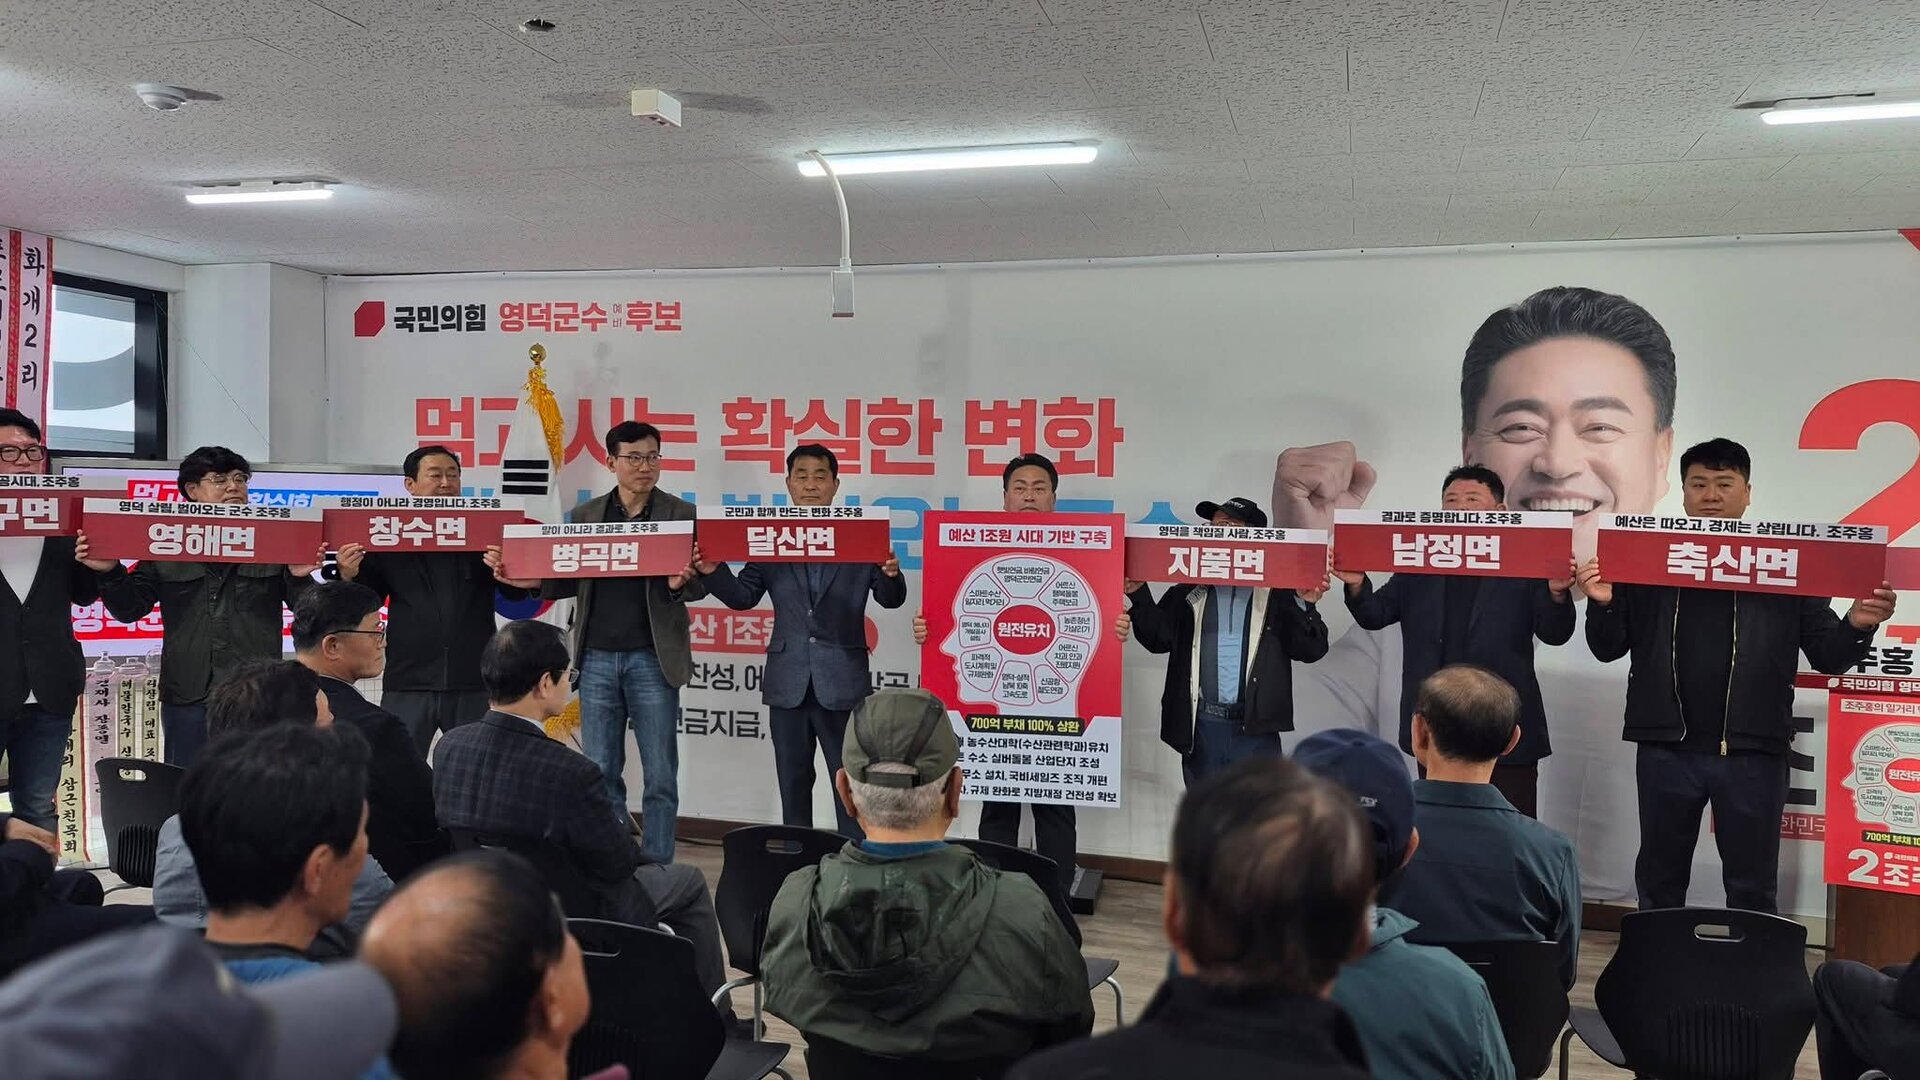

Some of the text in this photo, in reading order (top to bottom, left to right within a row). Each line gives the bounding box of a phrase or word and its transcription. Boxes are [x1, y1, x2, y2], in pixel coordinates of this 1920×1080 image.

[21, 247, 45, 391] 화개2리
[394, 304, 486, 332] 국민의힘
[499, 302, 607, 332] 영덕군수
[626, 301, 682, 331] 후보
[721, 397, 943, 475] 확실한
[965, 398, 1124, 477] 변화
[42, 477, 80, 487] 조주홍
[119, 501, 291, 518] 영덕 살림, 벌어오는 군수 조주홍
[341, 497, 501, 509] 행정이 아니라 경영입니다. 조주홍
[725, 507, 863, 518] 군민과 함께 만드는 변화 조주홍
[1382, 511, 1522, 525] 결과로 증명합니다. 조주홍
[369, 516, 466, 546] 창수면
[542, 526, 560, 535] 말이
[564, 525, 593, 535] 아니라
[631, 523, 659, 533] 조주홍
[1159, 525, 1286, 540] 영덕을 책임질 사람, 조주홍
[1615, 515, 1873, 540] 예산은 따오고, 경제는 살립니다. 조주홍
[149, 523, 255, 557] 영해면
[747, 526, 836, 556] 달산면
[949, 529, 1106, 545] 예산 1조원 시대 기반 구축
[552, 542, 639, 573] 병곡면
[1392, 533, 1500, 569] 남정면
[1168, 546, 1264, 580] 지품면
[1667, 541, 1799, 587] 축산면
[998, 622, 1050, 638] 원전유치
[1842, 678, 1894, 692] 국민의힘
[677, 707, 766, 740] 금지급,
[971, 717, 1080, 733] 700억 부채 100% 상환
[968, 753, 988, 763] 수소
[1036, 756, 1076, 767] 산업단지
[1080, 758, 1100, 769] 조성
[985, 770, 1007, 781] 설치,
[1009, 771, 1060, 784] 국비세일즈
[1064, 773, 1084, 785] 조직
[1087, 775, 1108, 786] 개편
[970, 785, 989, 796] 규제
[992, 787, 1021, 797] 완화로
[1024, 788, 1062, 800] 지방재정
[1066, 790, 1094, 801] 건전성
[1097, 791, 1118, 803] 확보
[1866, 832, 1890, 843] 700억
[1848, 849, 1879, 885] 2
